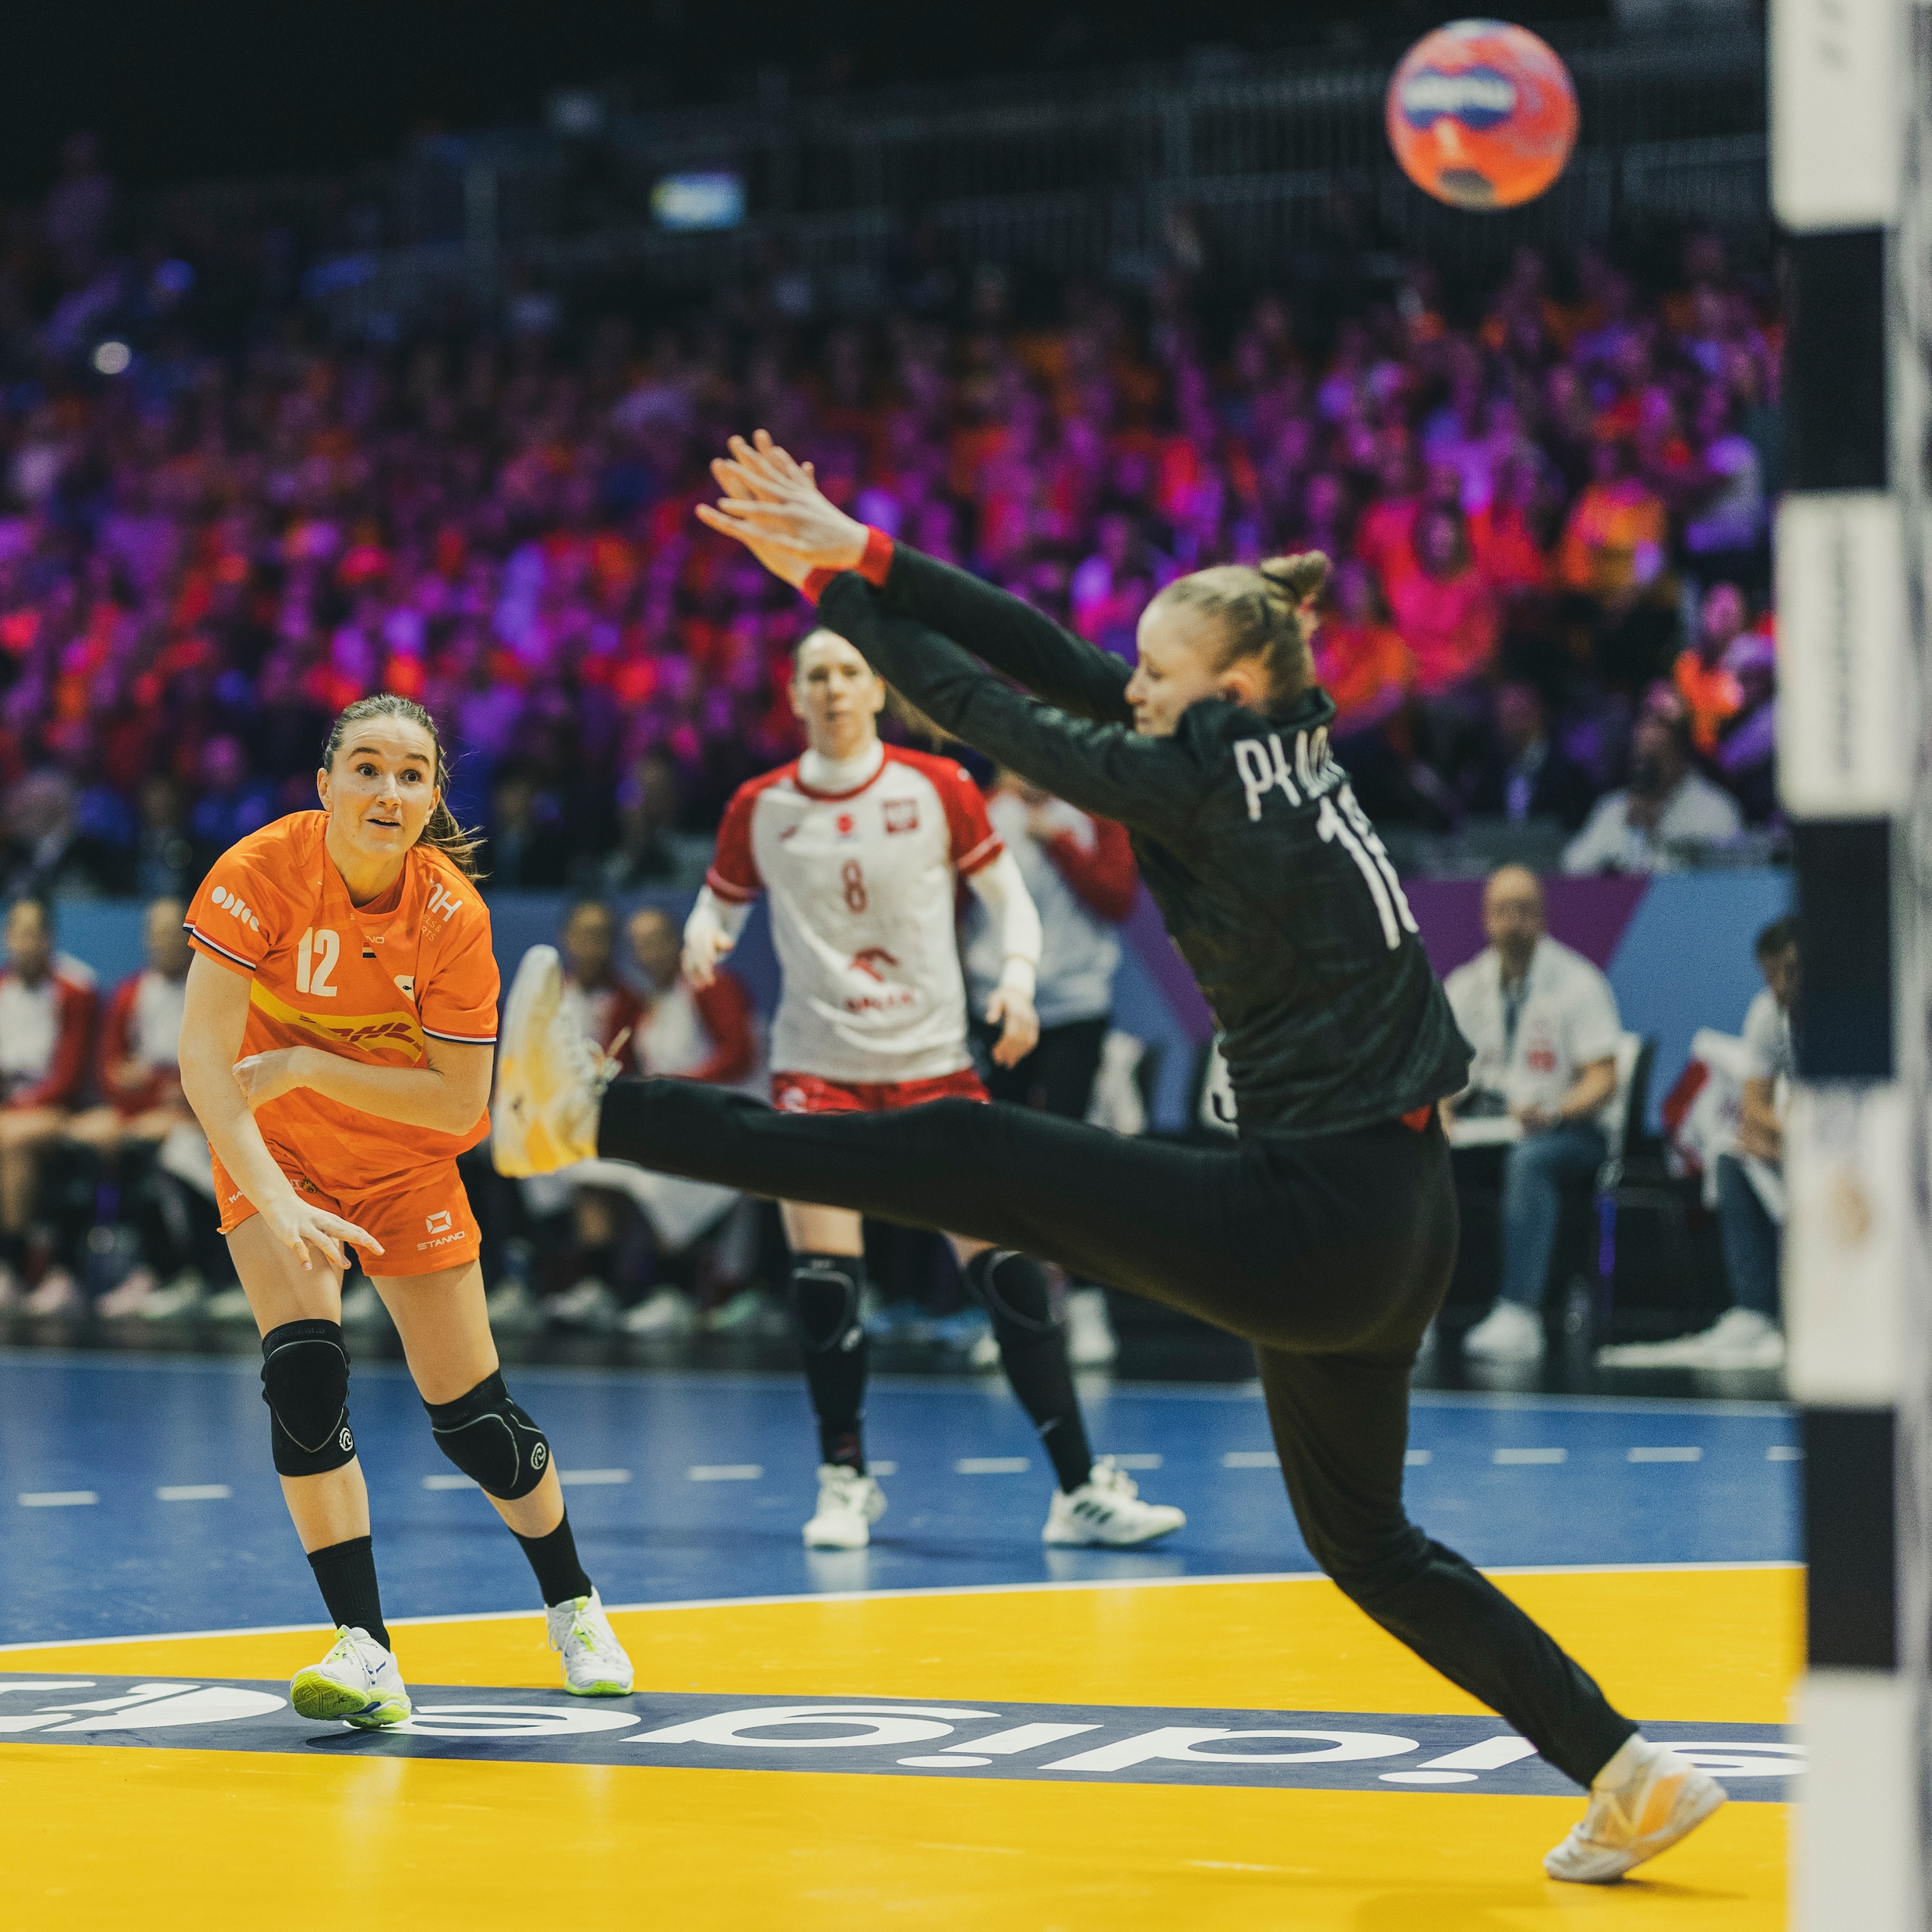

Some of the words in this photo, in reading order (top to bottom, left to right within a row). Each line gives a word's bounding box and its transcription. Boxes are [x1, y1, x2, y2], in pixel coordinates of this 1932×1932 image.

[841, 859, 868, 915] 8
[296, 927, 340, 996] 12
[417, 1231, 465, 1251] STANNO
